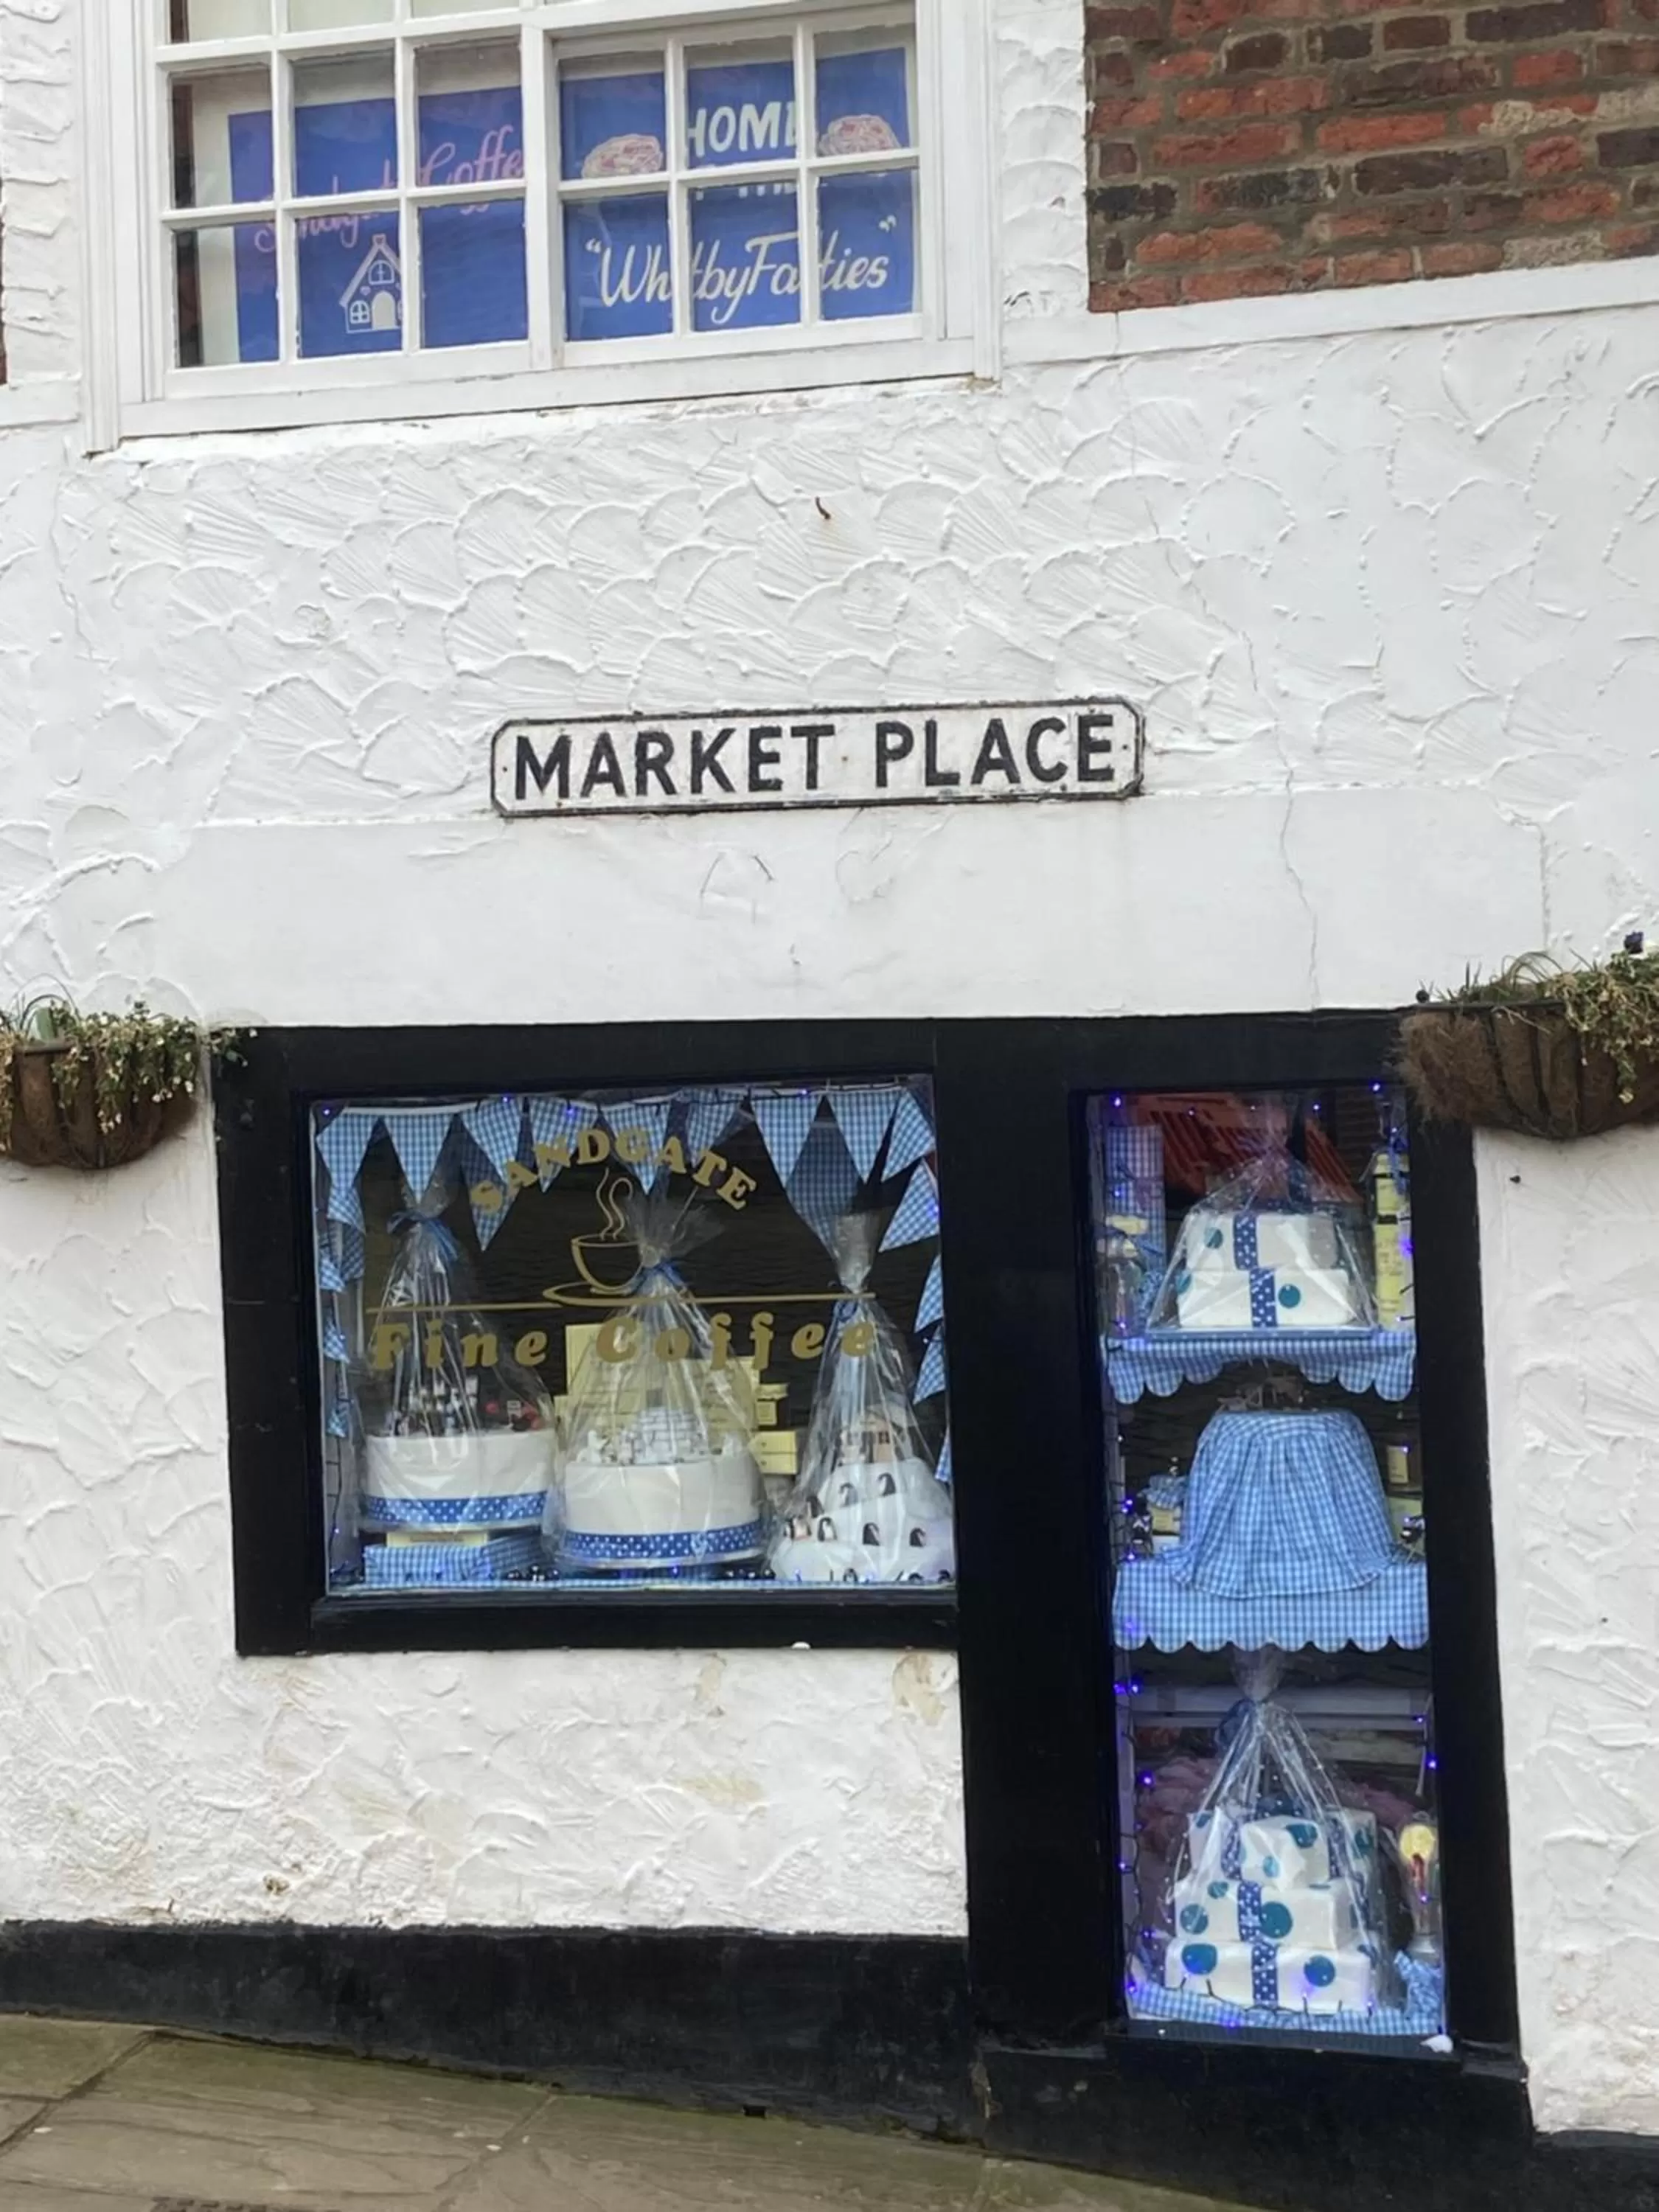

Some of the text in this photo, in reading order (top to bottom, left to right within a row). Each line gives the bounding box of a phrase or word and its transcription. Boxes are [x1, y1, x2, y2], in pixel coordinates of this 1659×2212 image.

[418, 124, 524, 215] Coffe
[514, 714, 1115, 800] MARKET PLACE
[470, 1127, 757, 1213] SANDGATE
[371, 1311, 874, 1371] Fine Coffee
